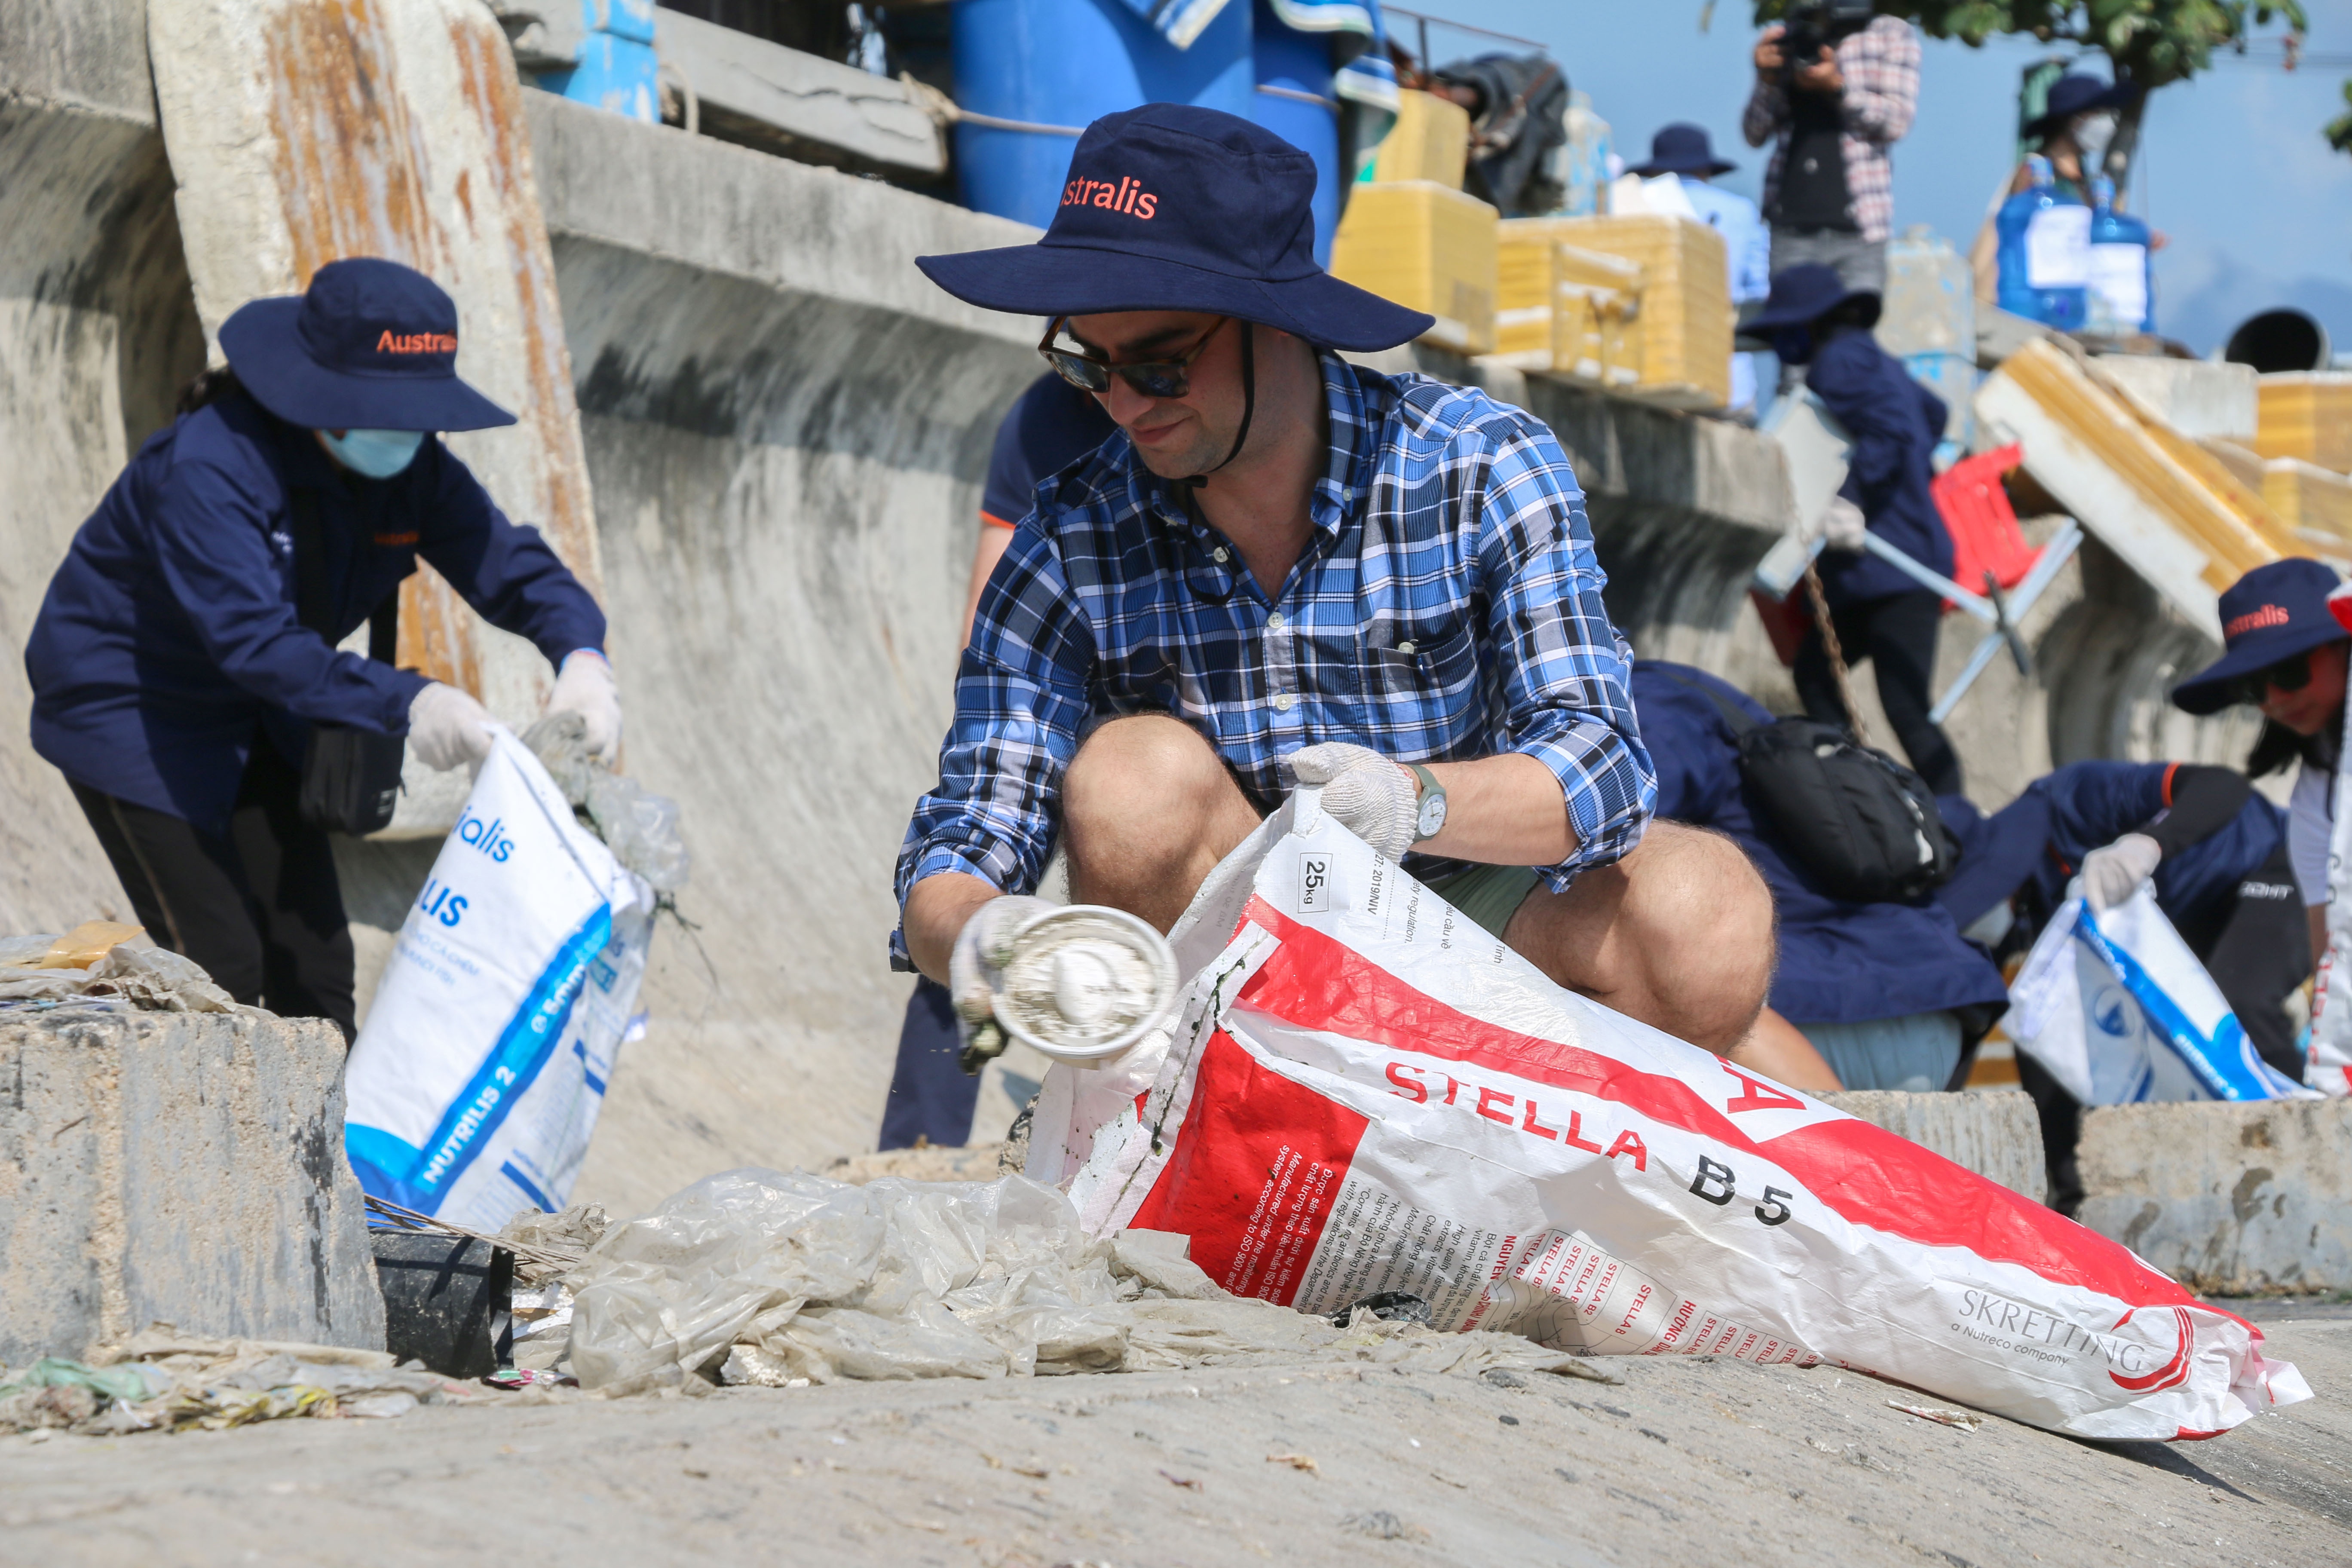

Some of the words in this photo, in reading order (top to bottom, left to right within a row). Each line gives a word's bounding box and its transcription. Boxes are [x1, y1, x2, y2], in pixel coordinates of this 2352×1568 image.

[1303, 861, 1326, 904] 25kg
[1368, 870, 1382, 914] 2019/NIV
[1404, 896, 1421, 943] regulation.
[1442, 918, 1455, 936] cầu
[1440, 939, 1452, 949] về
[423, 1088, 500, 1183] NUTRILIS
[496, 1066, 516, 1085] 2
[1385, 1060, 1647, 1173] STELLA
[1688, 1154, 1736, 1206] B
[1754, 1185, 1793, 1226] 5
[1272, 1145, 1289, 1179] system
[1305, 1162, 1319, 1183] chất
[1270, 1152, 1302, 1215] Manufactured
[1315, 1168, 1332, 1194] Được
[1344, 1181, 1357, 1200] with
[1250, 1179, 1274, 1222] according
[1292, 1184, 1311, 1211] lượng
[1308, 1197, 1319, 1213] sản
[1372, 1193, 1388, 1215] hành
[1247, 1223, 1257, 1233] to
[1260, 1215, 1274, 1240] under
[1285, 1213, 1299, 1231] theo
[1298, 1216, 1311, 1234] xuất
[1326, 1201, 1348, 1245] regulations
[1365, 1217, 1376, 1233] của
[1404, 1207, 1419, 1231] Mold
[1421, 1215, 1436, 1235] Chất
[1240, 1234, 1253, 1251] ISO
[1279, 1232, 1292, 1247] tiêu
[1343, 1229, 1351, 1240] no
[1359, 1234, 1371, 1246] Bộ
[1371, 1233, 1385, 1253] chứa
[1431, 1220, 1451, 1252] extracts,
[1452, 1224, 1466, 1245] High
[1462, 1230, 1482, 1261] vitamin,
[1483, 1233, 1496, 1248] Bột
[1253, 1240, 1265, 1253] the
[1290, 1237, 1304, 1255] dưới
[1321, 1246, 1332, 1256] of
[1348, 1246, 1366, 1268] Nông
[1389, 1230, 1408, 1264] inhibitors
[1408, 1236, 1426, 1260] chống
[1478, 1250, 1488, 1261] cá
[1490, 1235, 1516, 1279] NGUYÊN
[1521, 1234, 1546, 1265] STELLA
[1538, 1236, 1563, 1274] STELLA
[1232, 1251, 1246, 1271] 9001
[1269, 1249, 1284, 1270] chuẩn
[1284, 1256, 1295, 1267] sự
[1317, 1255, 1327, 1267] the
[1326, 1241, 1346, 1279] antibiotics
[1359, 1254, 1376, 1276] kháng
[1403, 1261, 1414, 1277] mốc
[1420, 1256, 1437, 1284] vitamins,
[1439, 1248, 1455, 1272] quality
[1556, 1246, 1581, 1283] STELLA
[1226, 1271, 1236, 1285] and
[1235, 1255, 1258, 1292] monitoring
[1263, 1271, 1274, 1285] ISO
[1277, 1268, 1291, 1286] kiểm
[1338, 1268, 1357, 1292] Nghiệp
[1449, 1264, 1470, 1289] khoáng
[1470, 1263, 1482, 1281] chất
[1574, 1255, 1599, 1292] STELLA
[1592, 1263, 1617, 1302] STELLA
[1299, 1268, 1323, 1308] Department
[1320, 1279, 1330, 1294] and
[1356, 1277, 1366, 1292] sinh
[1425, 1275, 1445, 1302] fishmeal,
[1316, 1294, 1324, 1302] no
[1437, 1298, 1452, 1311] lượng
[1620, 1284, 1651, 1329] STELLA
[1449, 1308, 1461, 1317] đạm
[1583, 1304, 1596, 1315] B2
[1442, 1318, 1455, 1329] thực
[1460, 1318, 1479, 1332] MAIN
[1664, 1300, 1696, 1342] HƯỚNG
[1692, 1317, 1717, 1347] STELLA
[1958, 1289, 2145, 1372] SKRETTING
[1712, 1326, 1737, 1354] STELLA
[1951, 1322, 1960, 1330] a
[1963, 1326, 2011, 1350] Nutreco
[2014, 1343, 2069, 1367] company
[1755, 1340, 1778, 1363] STELL
